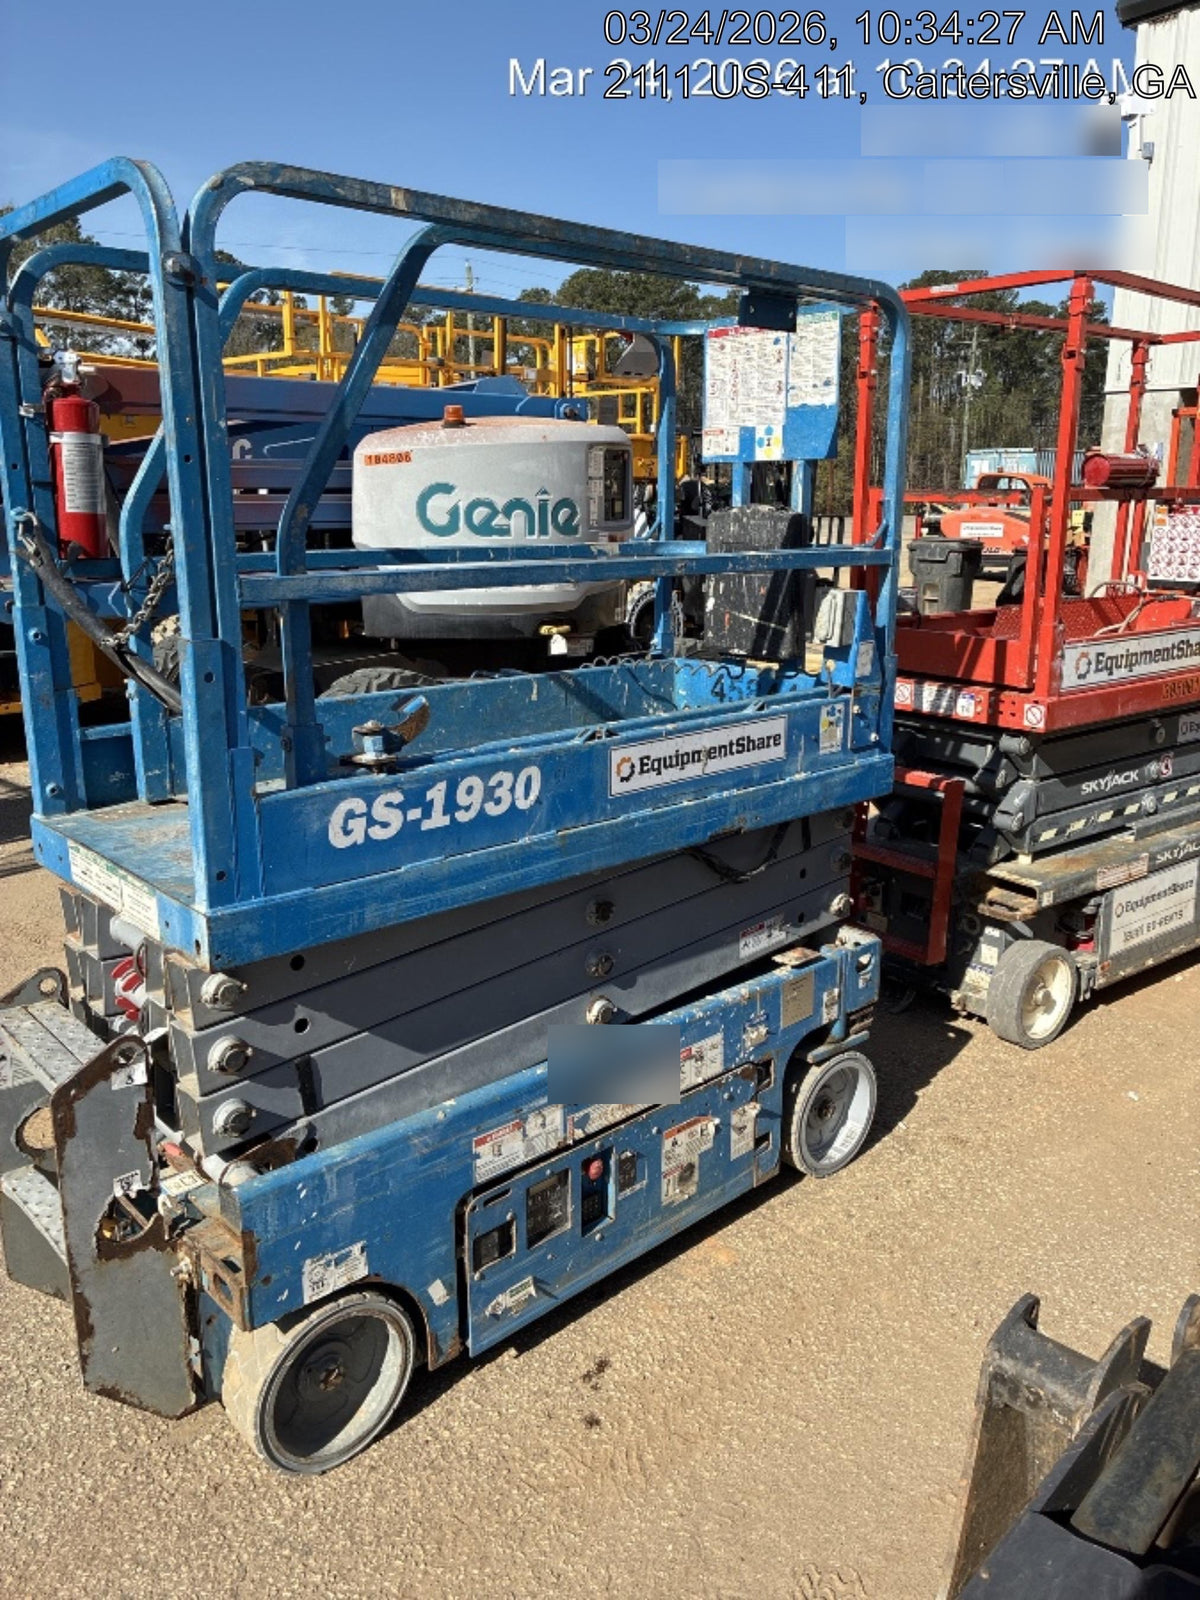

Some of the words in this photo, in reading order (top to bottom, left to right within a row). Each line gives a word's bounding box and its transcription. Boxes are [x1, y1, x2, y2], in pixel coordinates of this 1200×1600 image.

[416, 482, 581, 538] Genie
[638, 733, 782, 776] EquipmentShare
[1081, 770, 1139, 795] SKYJACK
[328, 766, 541, 849] GS-1930
